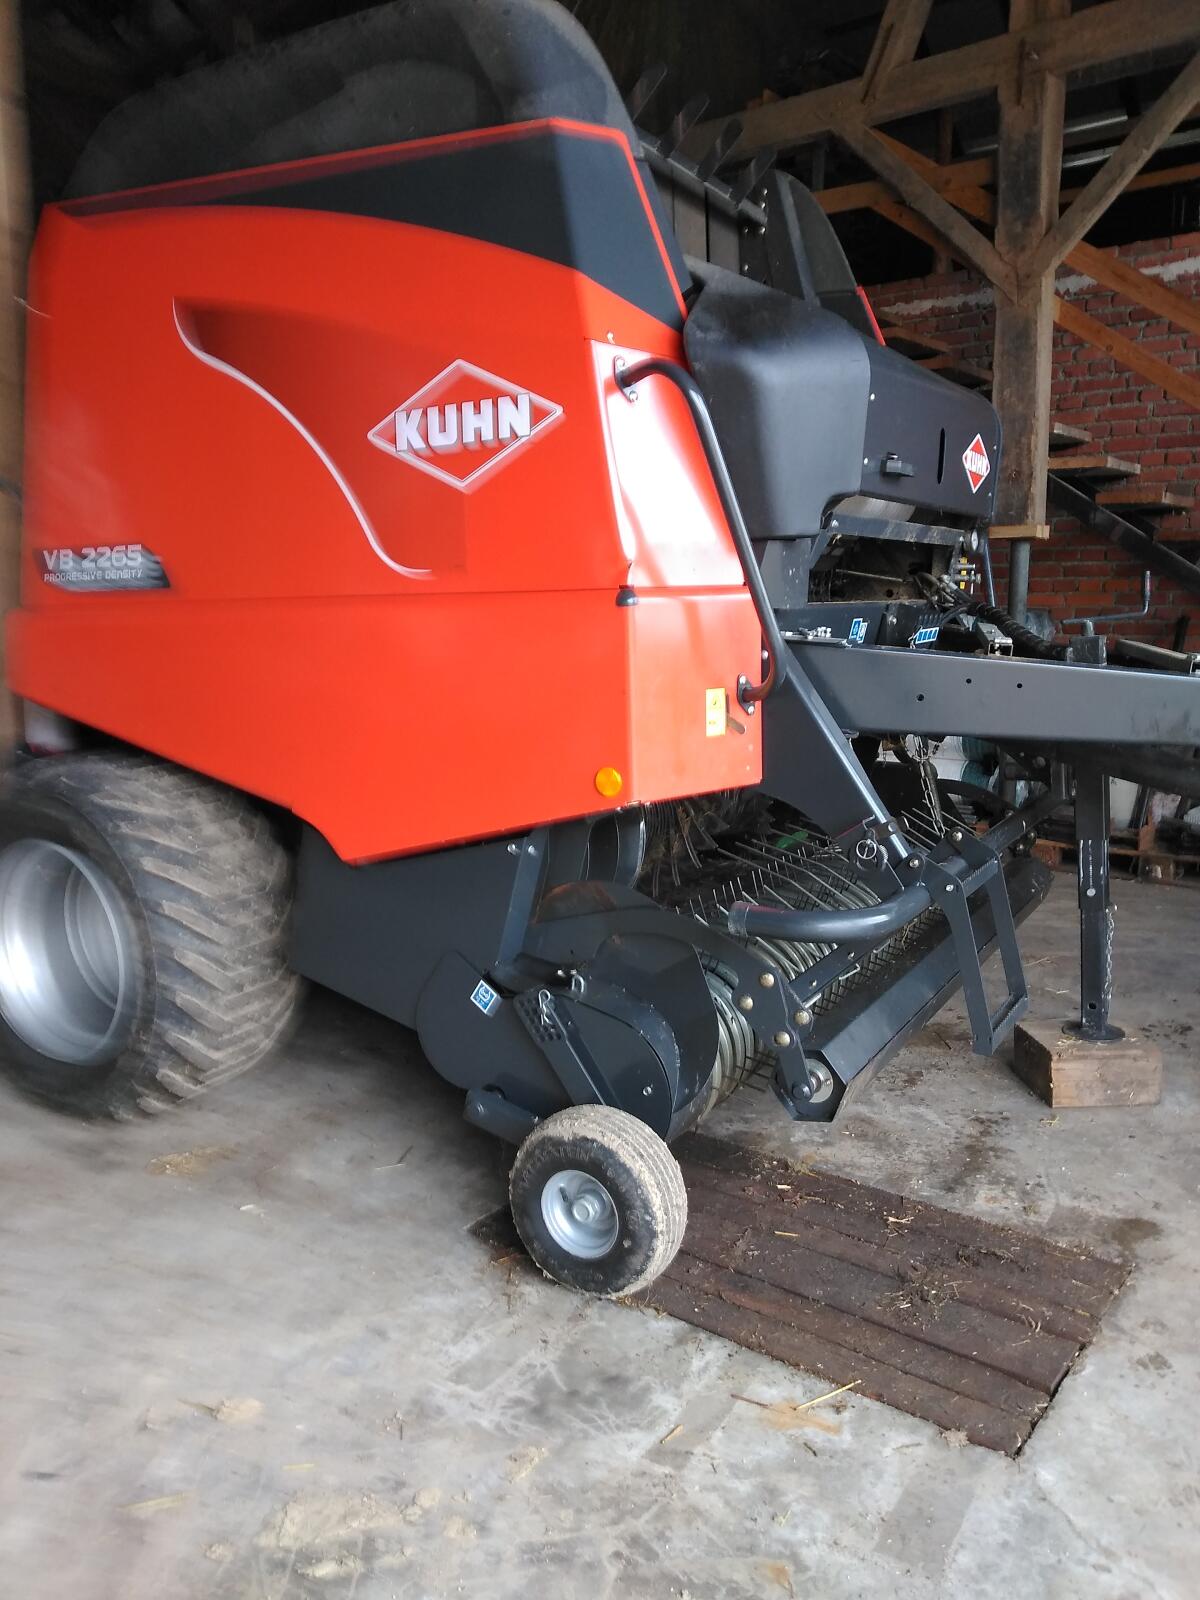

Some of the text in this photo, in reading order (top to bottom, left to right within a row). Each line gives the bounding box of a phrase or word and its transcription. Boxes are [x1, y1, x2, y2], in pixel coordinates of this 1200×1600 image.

[395, 393, 531, 452] KUHN
[966, 450, 988, 477] KUHN
[43, 544, 142, 570] VB 2265
[44, 571, 102, 582] PROGRESSIVE
